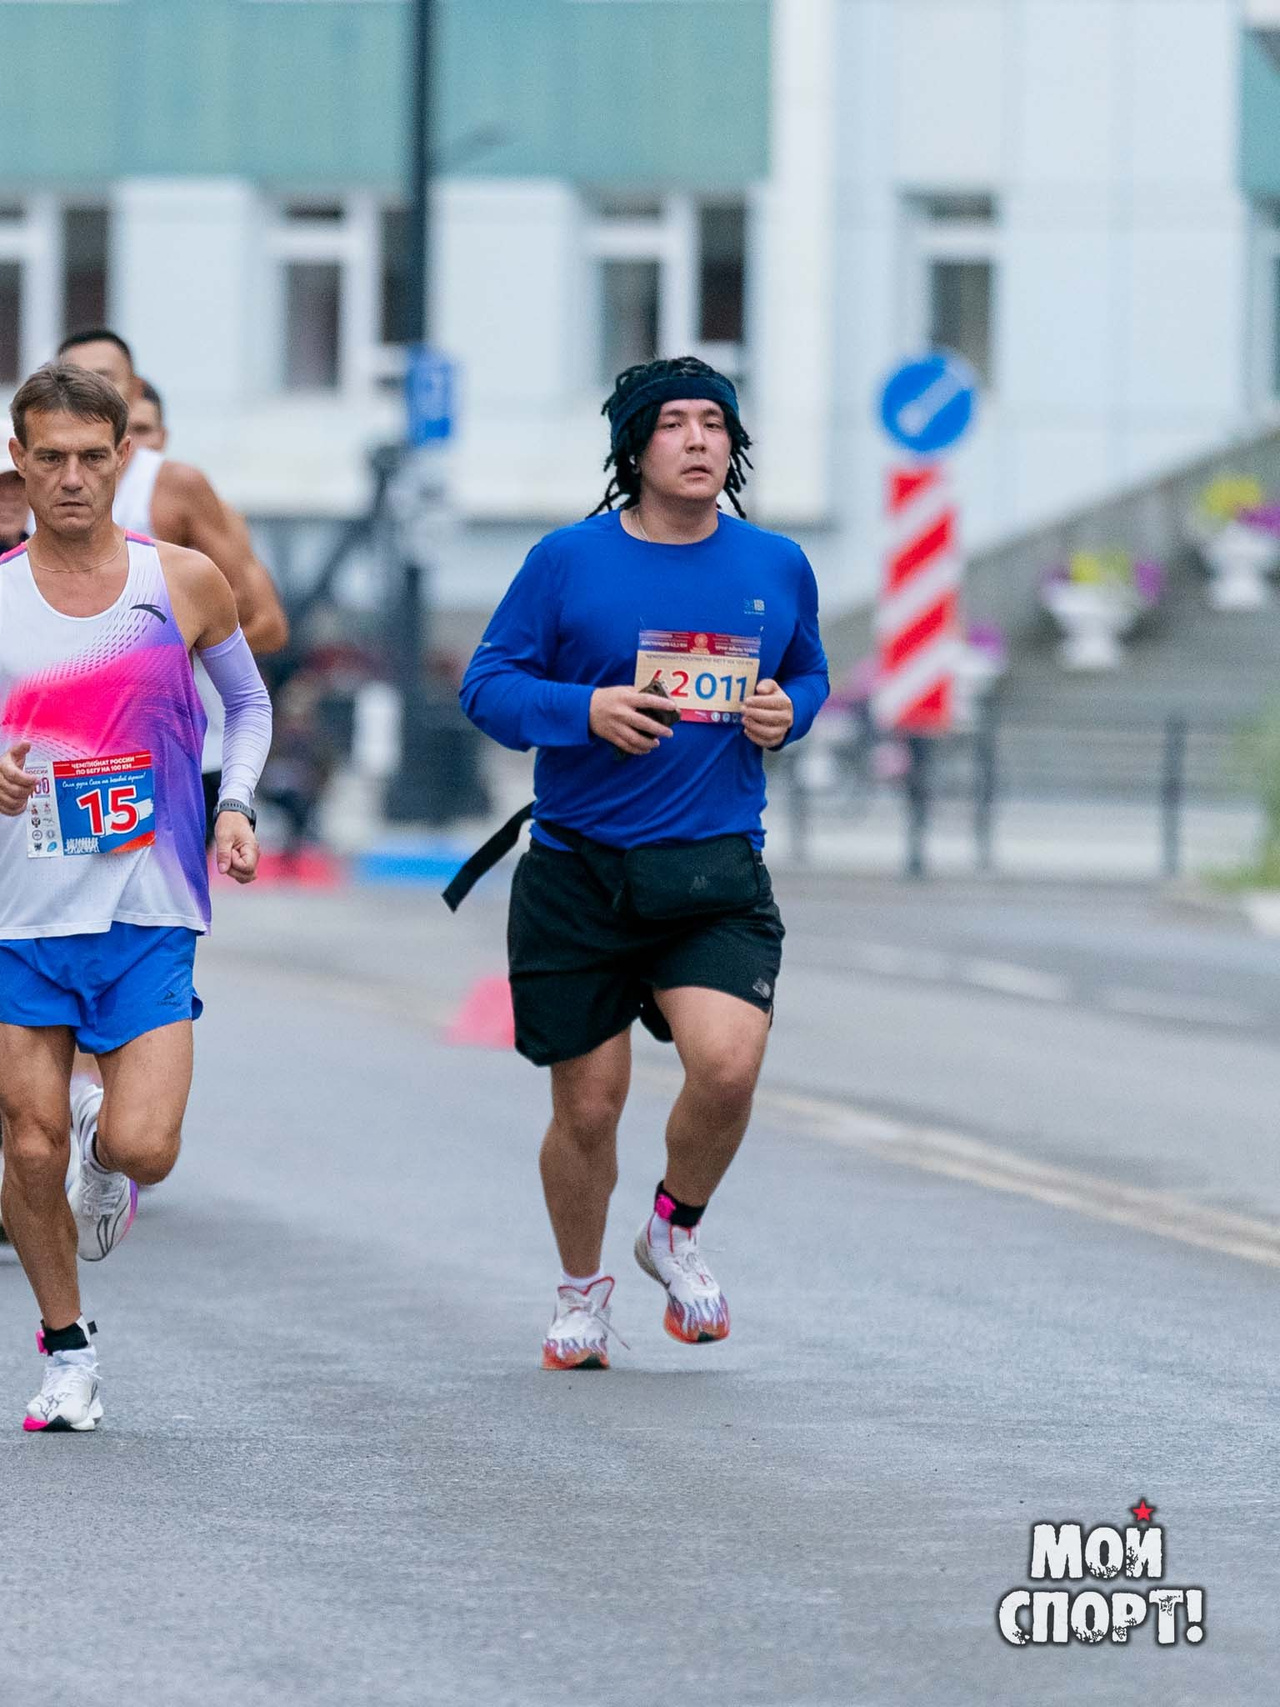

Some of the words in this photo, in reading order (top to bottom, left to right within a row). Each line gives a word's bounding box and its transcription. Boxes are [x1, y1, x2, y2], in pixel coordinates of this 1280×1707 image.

[652, 669, 747, 702] 2011
[71, 760, 109, 769] ЧЕМПИОНАТ
[110, 757, 135, 765] РОССИИ
[30, 777, 50, 798] 00
[76, 784, 139, 835] 15
